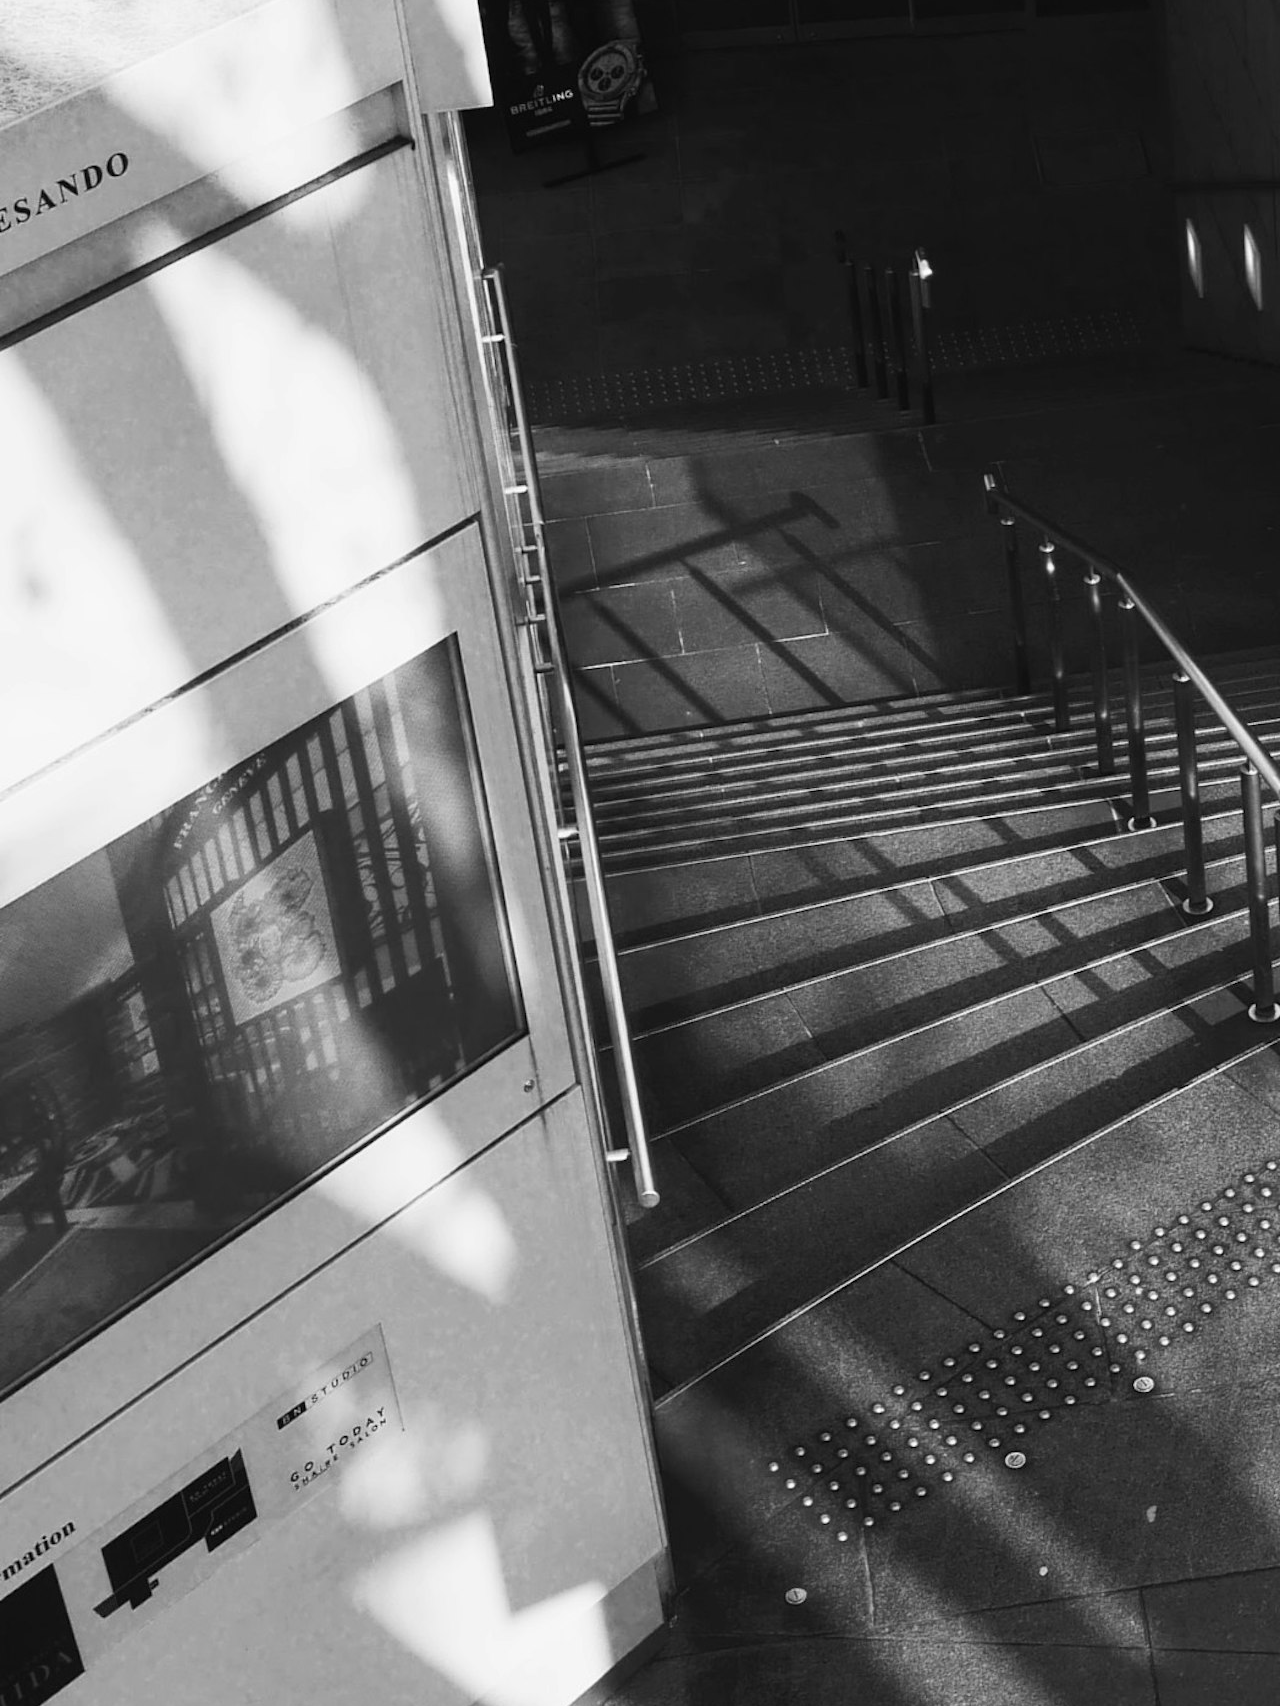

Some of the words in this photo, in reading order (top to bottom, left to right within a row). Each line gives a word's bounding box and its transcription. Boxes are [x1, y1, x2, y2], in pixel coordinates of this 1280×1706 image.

[510, 89, 575, 117] BREITLING
[282, 1407, 302, 1425] BN
[311, 1357, 368, 1404] STUDIO
[290, 1460, 314, 1483] GO
[327, 1406, 384, 1454] TODAY
[350, 1419, 387, 1448] SALON
[0, 1522, 76, 1581] mation
